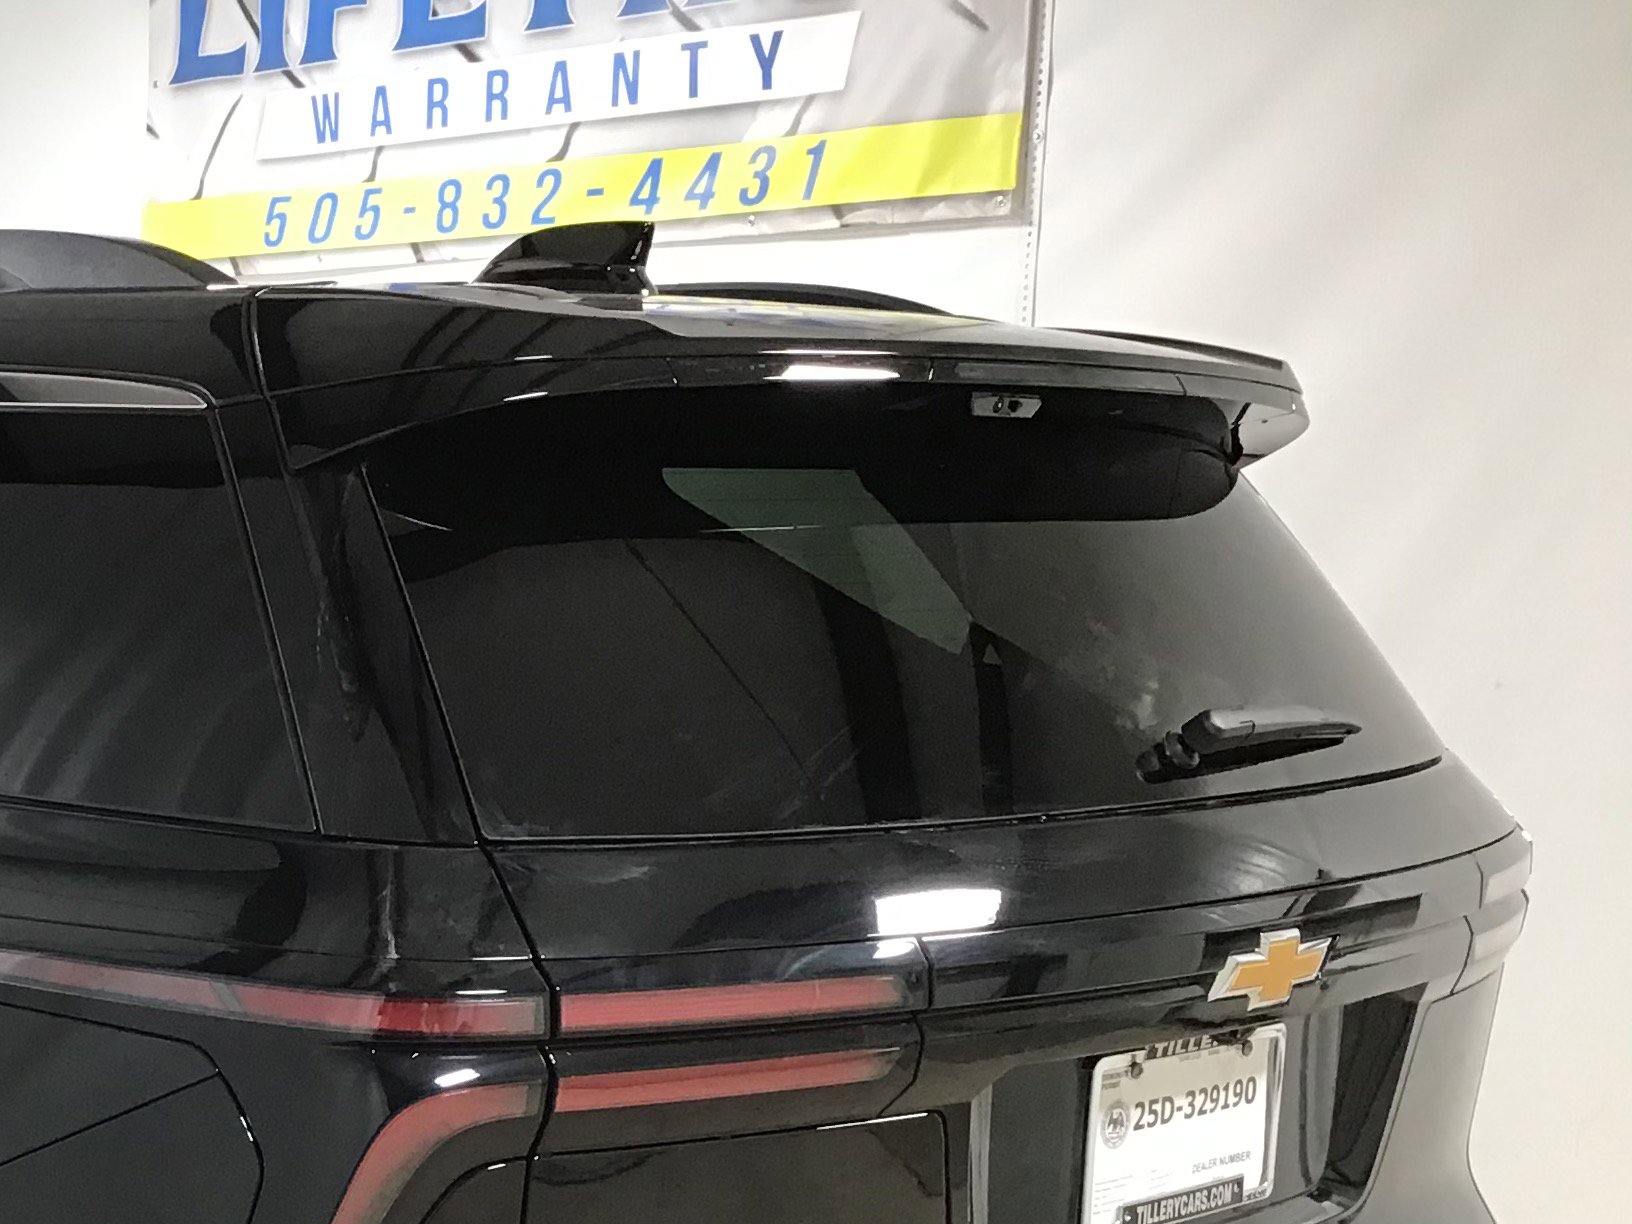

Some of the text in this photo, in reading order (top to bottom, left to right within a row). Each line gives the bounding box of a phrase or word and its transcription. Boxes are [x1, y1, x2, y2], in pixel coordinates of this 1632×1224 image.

[312, 30, 786, 145] WARRANTY
[264, 138, 830, 248] 505-832-4431
[1132, 1075, 1258, 1131] 25D-329190
[1191, 1150, 1251, 1174] DEALER NUMBER
